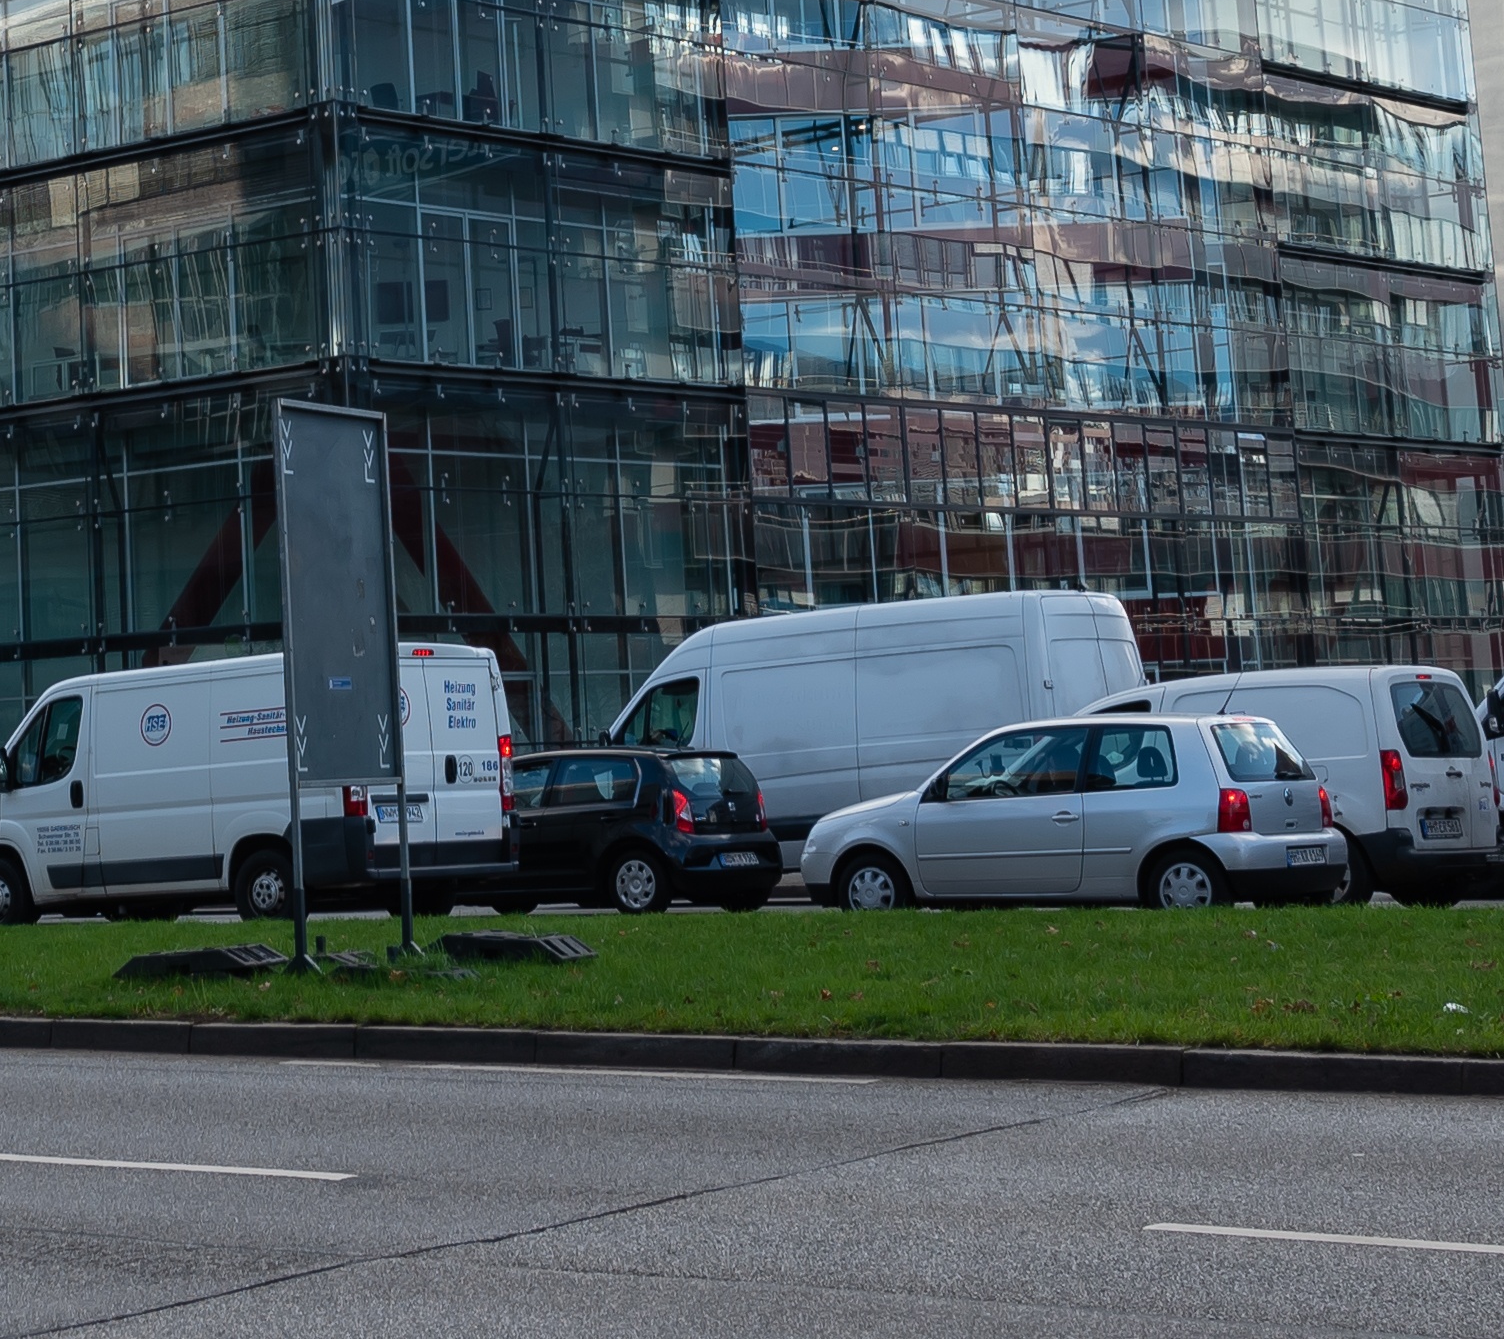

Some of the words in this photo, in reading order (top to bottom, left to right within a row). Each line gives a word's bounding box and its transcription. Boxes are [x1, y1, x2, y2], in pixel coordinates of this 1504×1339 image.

[443, 679, 476, 696] Heizung
[446, 696, 476, 712] Sanitär
[448, 714, 477, 730] Elektro
